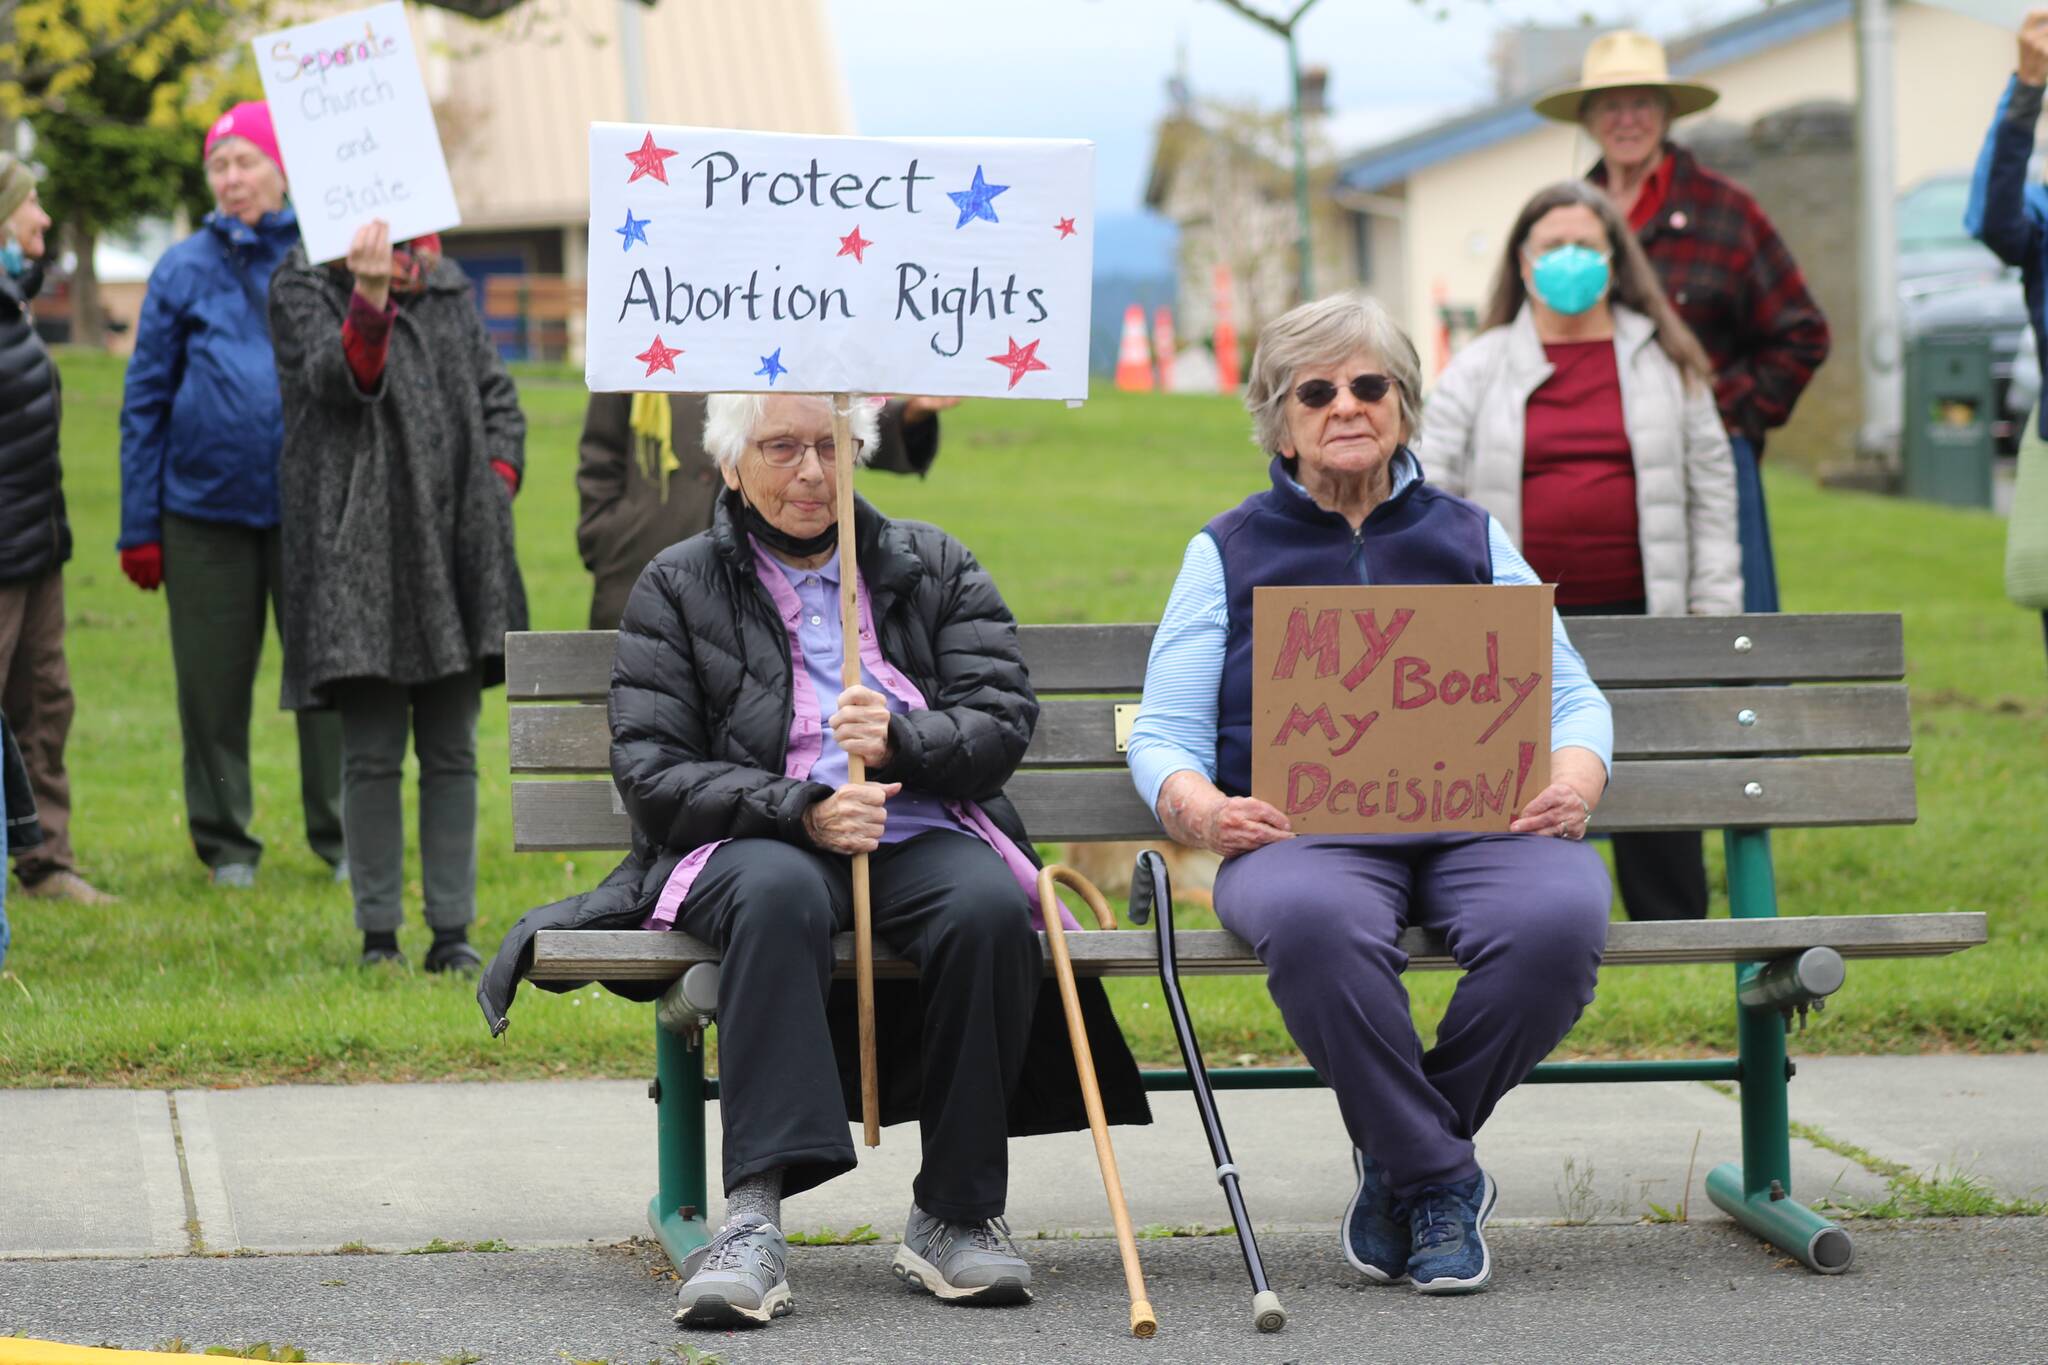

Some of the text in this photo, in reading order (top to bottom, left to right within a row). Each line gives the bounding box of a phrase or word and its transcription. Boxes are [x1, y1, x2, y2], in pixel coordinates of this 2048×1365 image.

[271, 21, 398, 83] Separate
[300, 68, 395, 121] Church
[336, 127, 378, 161] and
[324, 173, 410, 220] State
[691, 150, 935, 214] Protect
[618, 262, 1048, 357] Abortion Rights
[1392, 631, 1542, 745] Body
